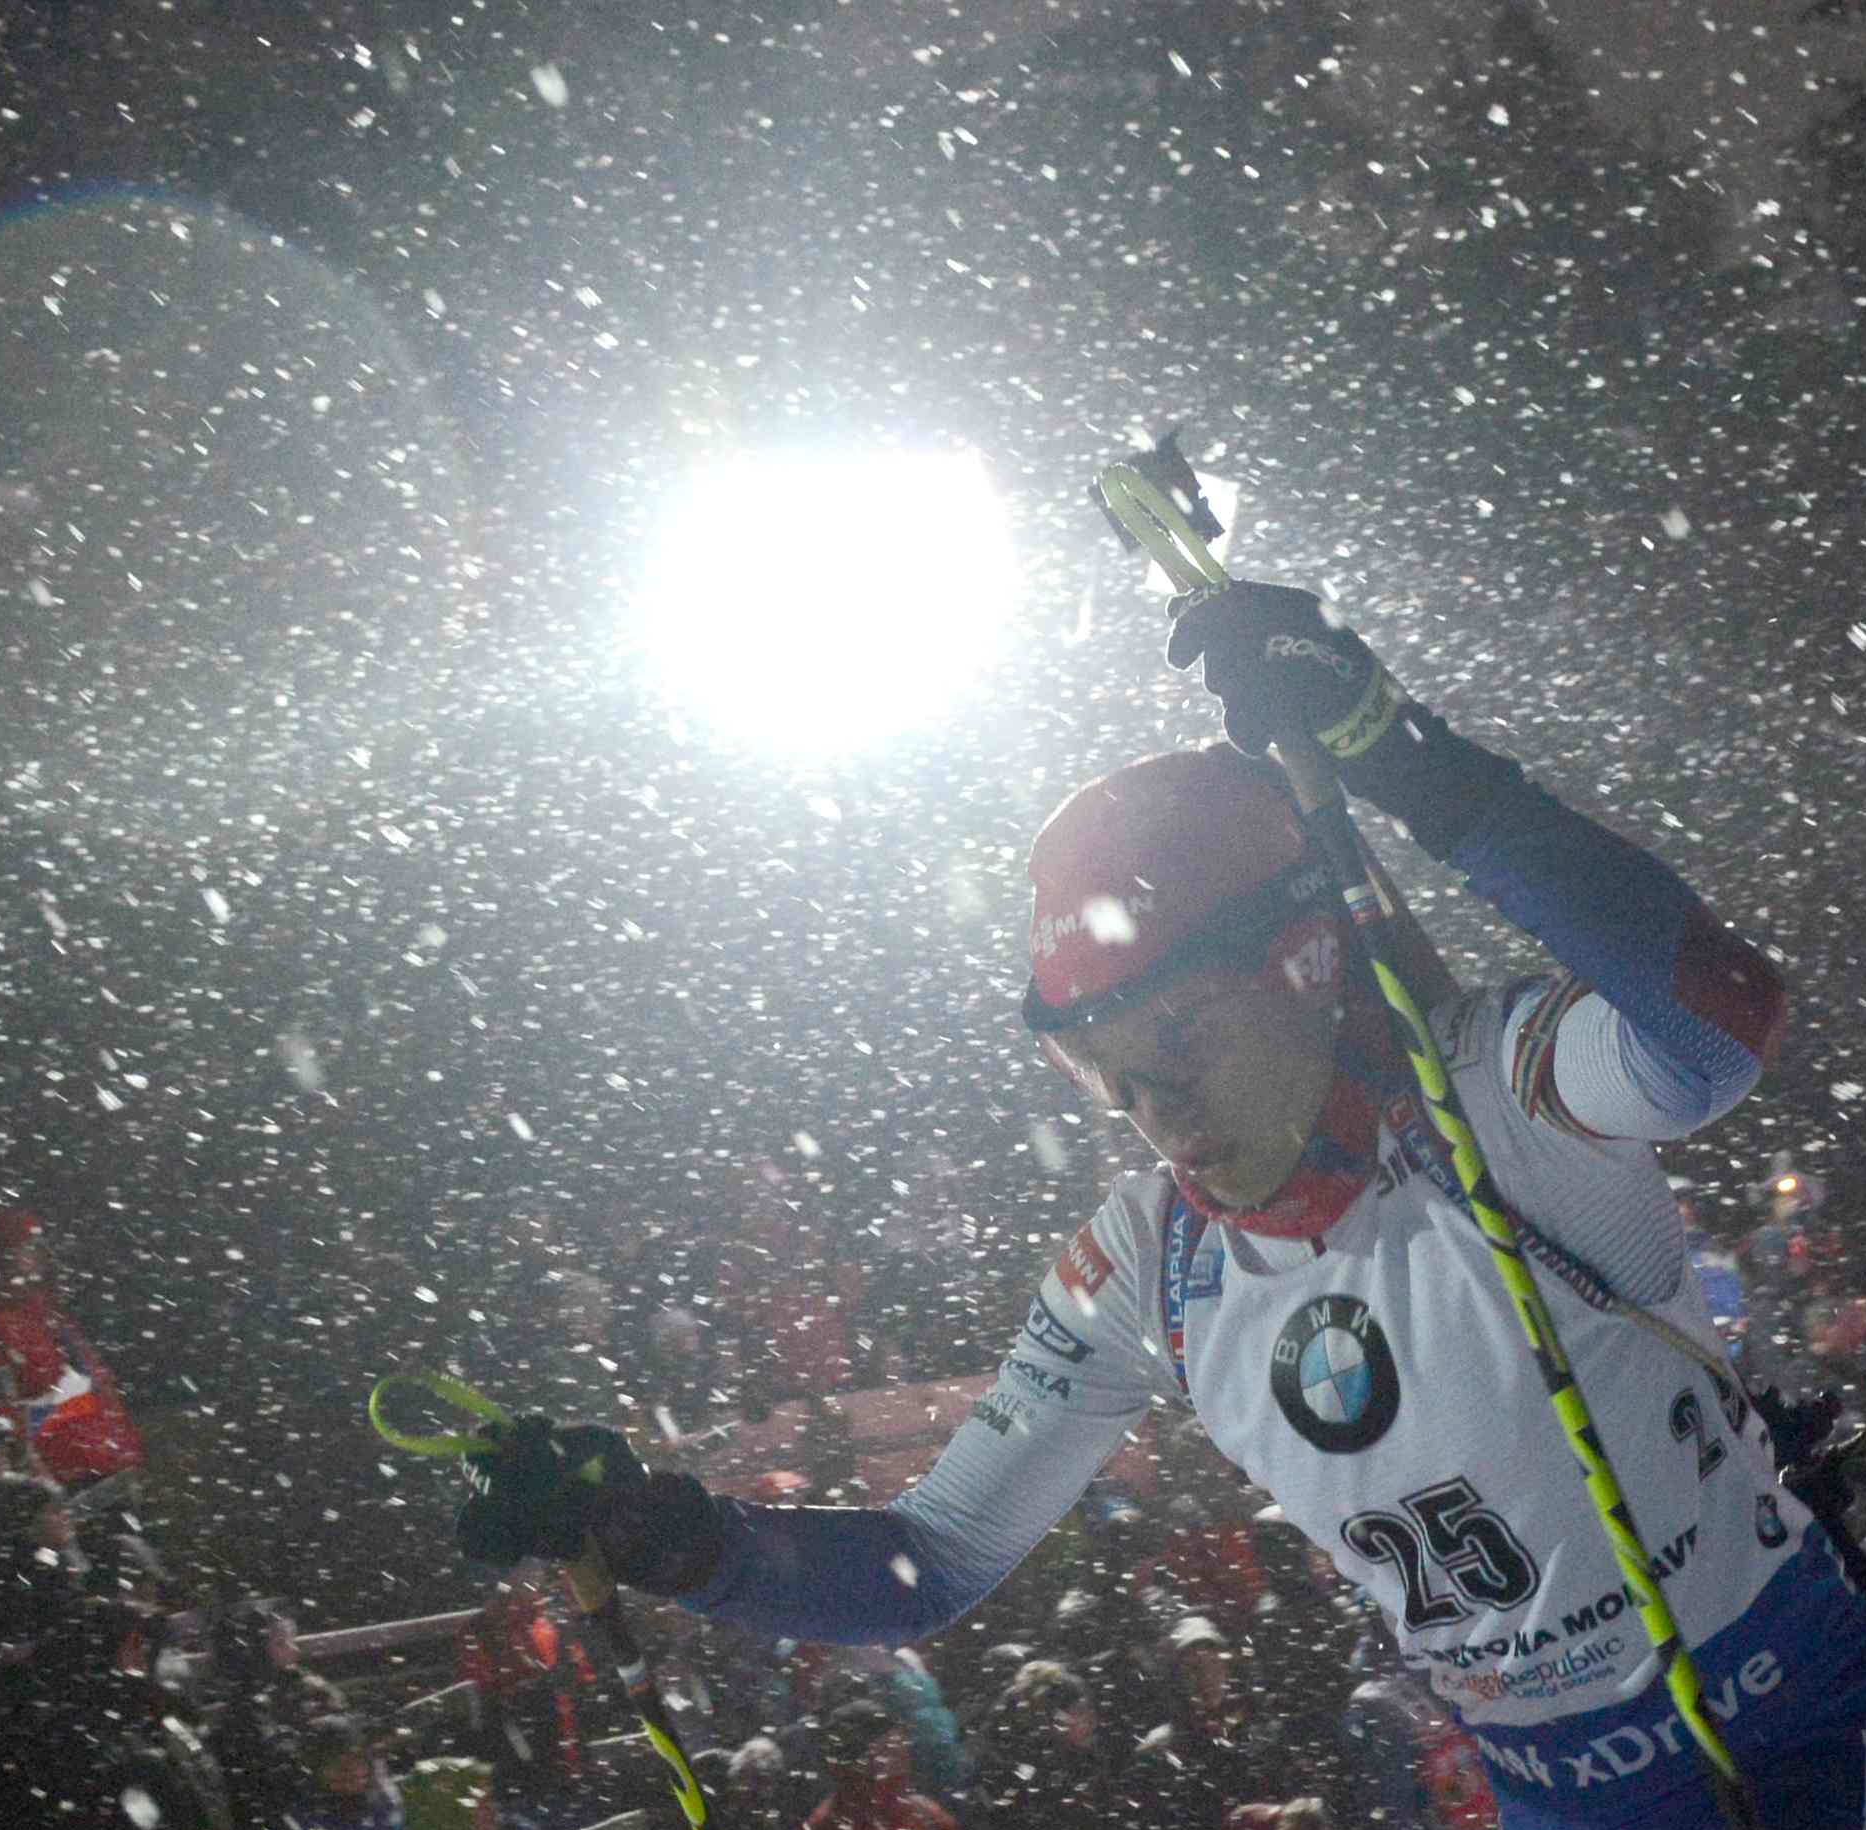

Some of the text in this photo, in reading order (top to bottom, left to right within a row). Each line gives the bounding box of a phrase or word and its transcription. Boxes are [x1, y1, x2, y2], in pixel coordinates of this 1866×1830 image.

[1169, 1214, 1187, 1326] LAPUA
[1340, 1474, 1542, 1634] 25
[1558, 1647, 1785, 1788] xDrve
